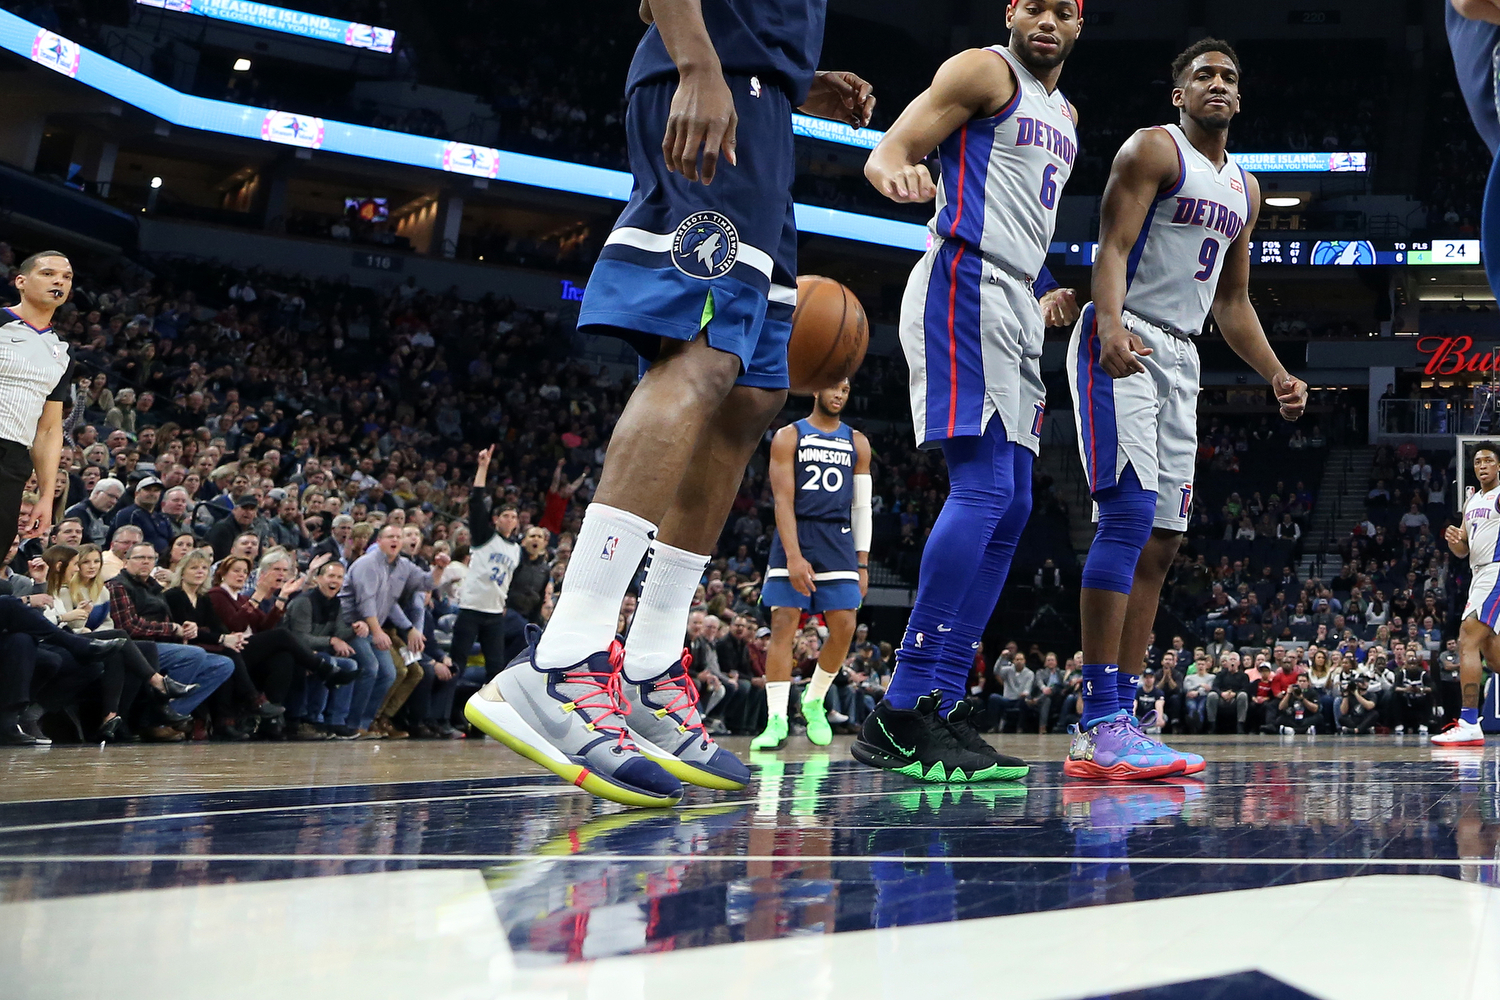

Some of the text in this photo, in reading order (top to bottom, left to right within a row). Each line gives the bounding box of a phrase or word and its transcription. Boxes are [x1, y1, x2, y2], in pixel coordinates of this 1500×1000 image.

[255, 16, 286, 30] THAN
[287, 21, 308, 34] YOU
[792, 115, 845, 134] TREASURE
[830, 133, 851, 142] THAN
[852, 136, 867, 145] YOU
[1015, 117, 1077, 170] DETROI
[1039, 163, 1058, 211] 6
[1171, 196, 1244, 243] DETROI
[673, 214, 737, 272] MINNESOTA TIMBERWOLVES
[1262, 241, 1300, 249] FG% 42
[1445, 243, 1466, 258] 24
[1194, 237, 1220, 282] 9
[1261, 255, 1282, 263] 3PT%
[798, 448, 851, 467] MINNESOTA
[801, 465, 843, 493] 20
[1465, 507, 1492, 521] ETROIT
[1472, 522, 1478, 540] 7
